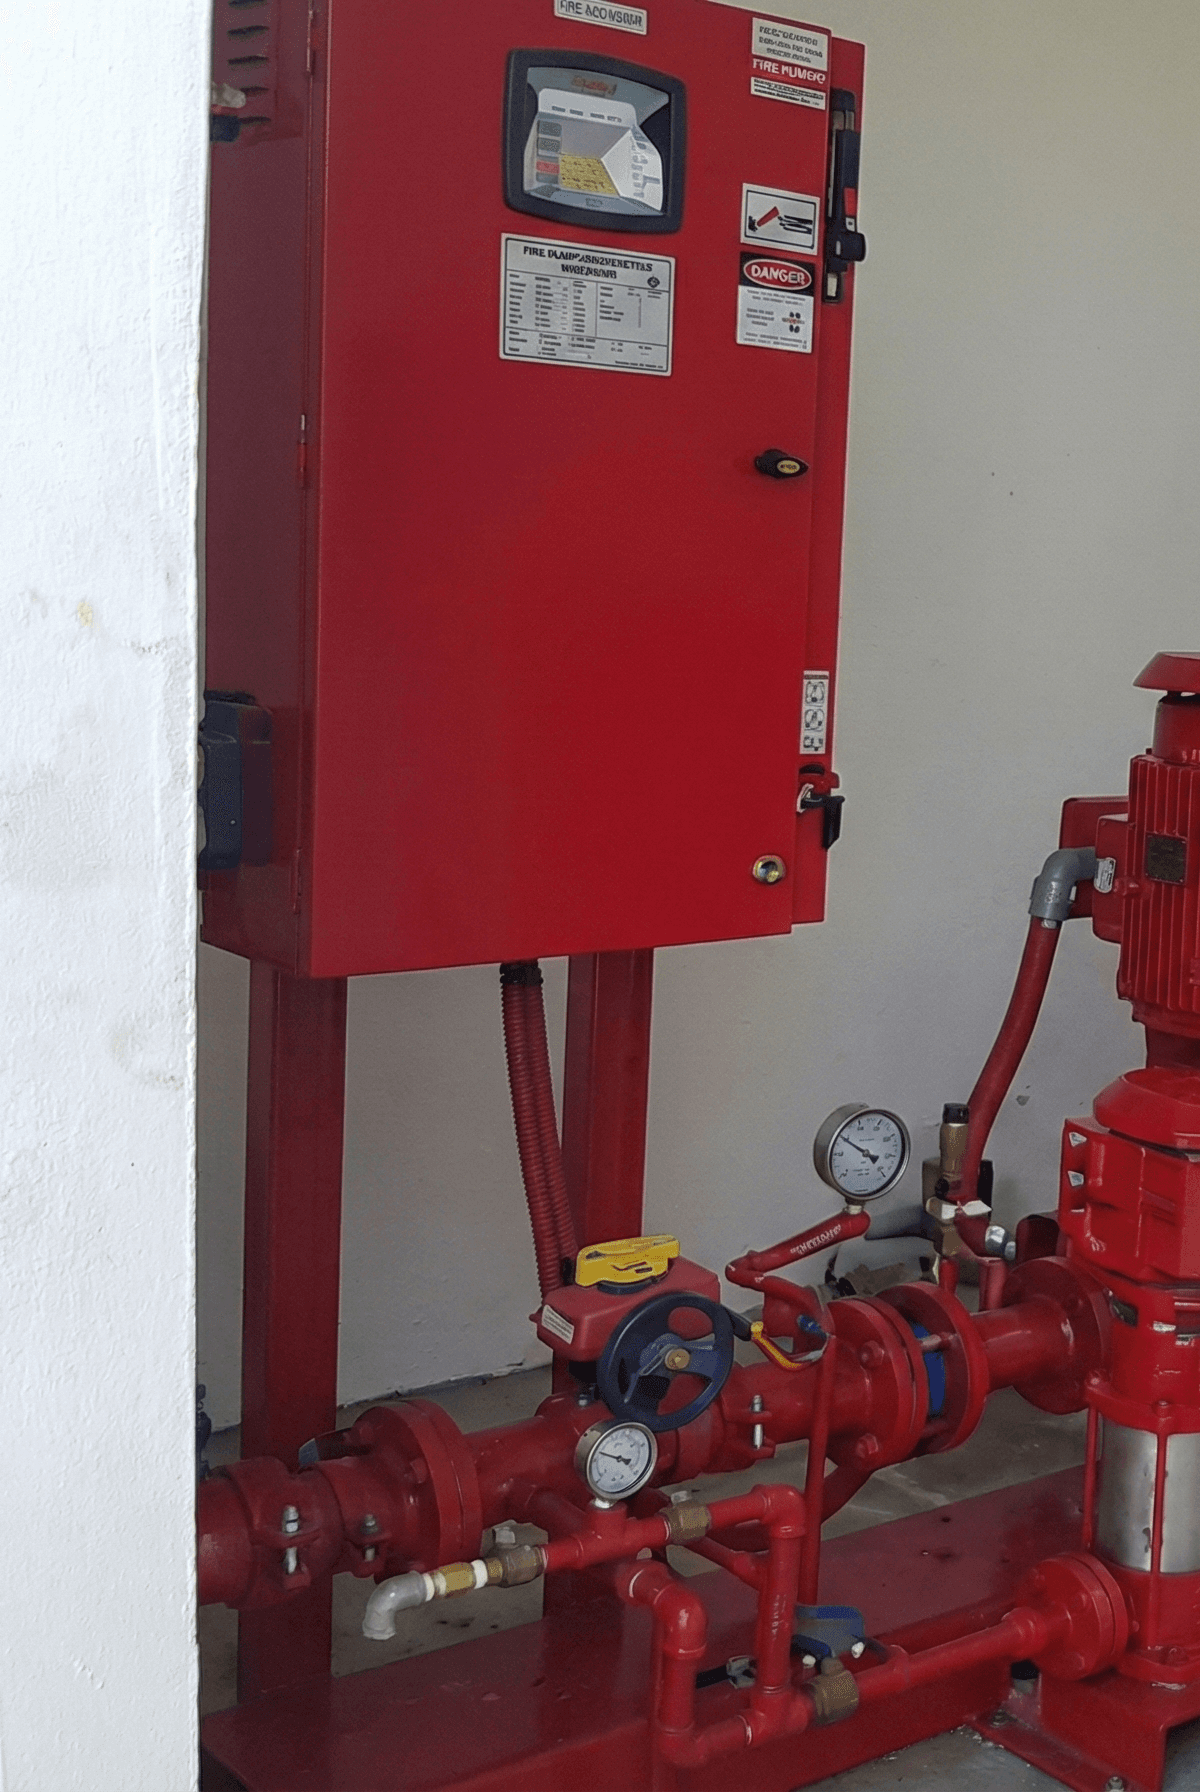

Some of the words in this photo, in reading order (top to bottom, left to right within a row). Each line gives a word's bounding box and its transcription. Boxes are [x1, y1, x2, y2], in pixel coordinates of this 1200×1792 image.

[753, 58, 779, 74] FIRE
[524, 246, 546, 258] FIRE
[751, 264, 806, 285] DANGER
